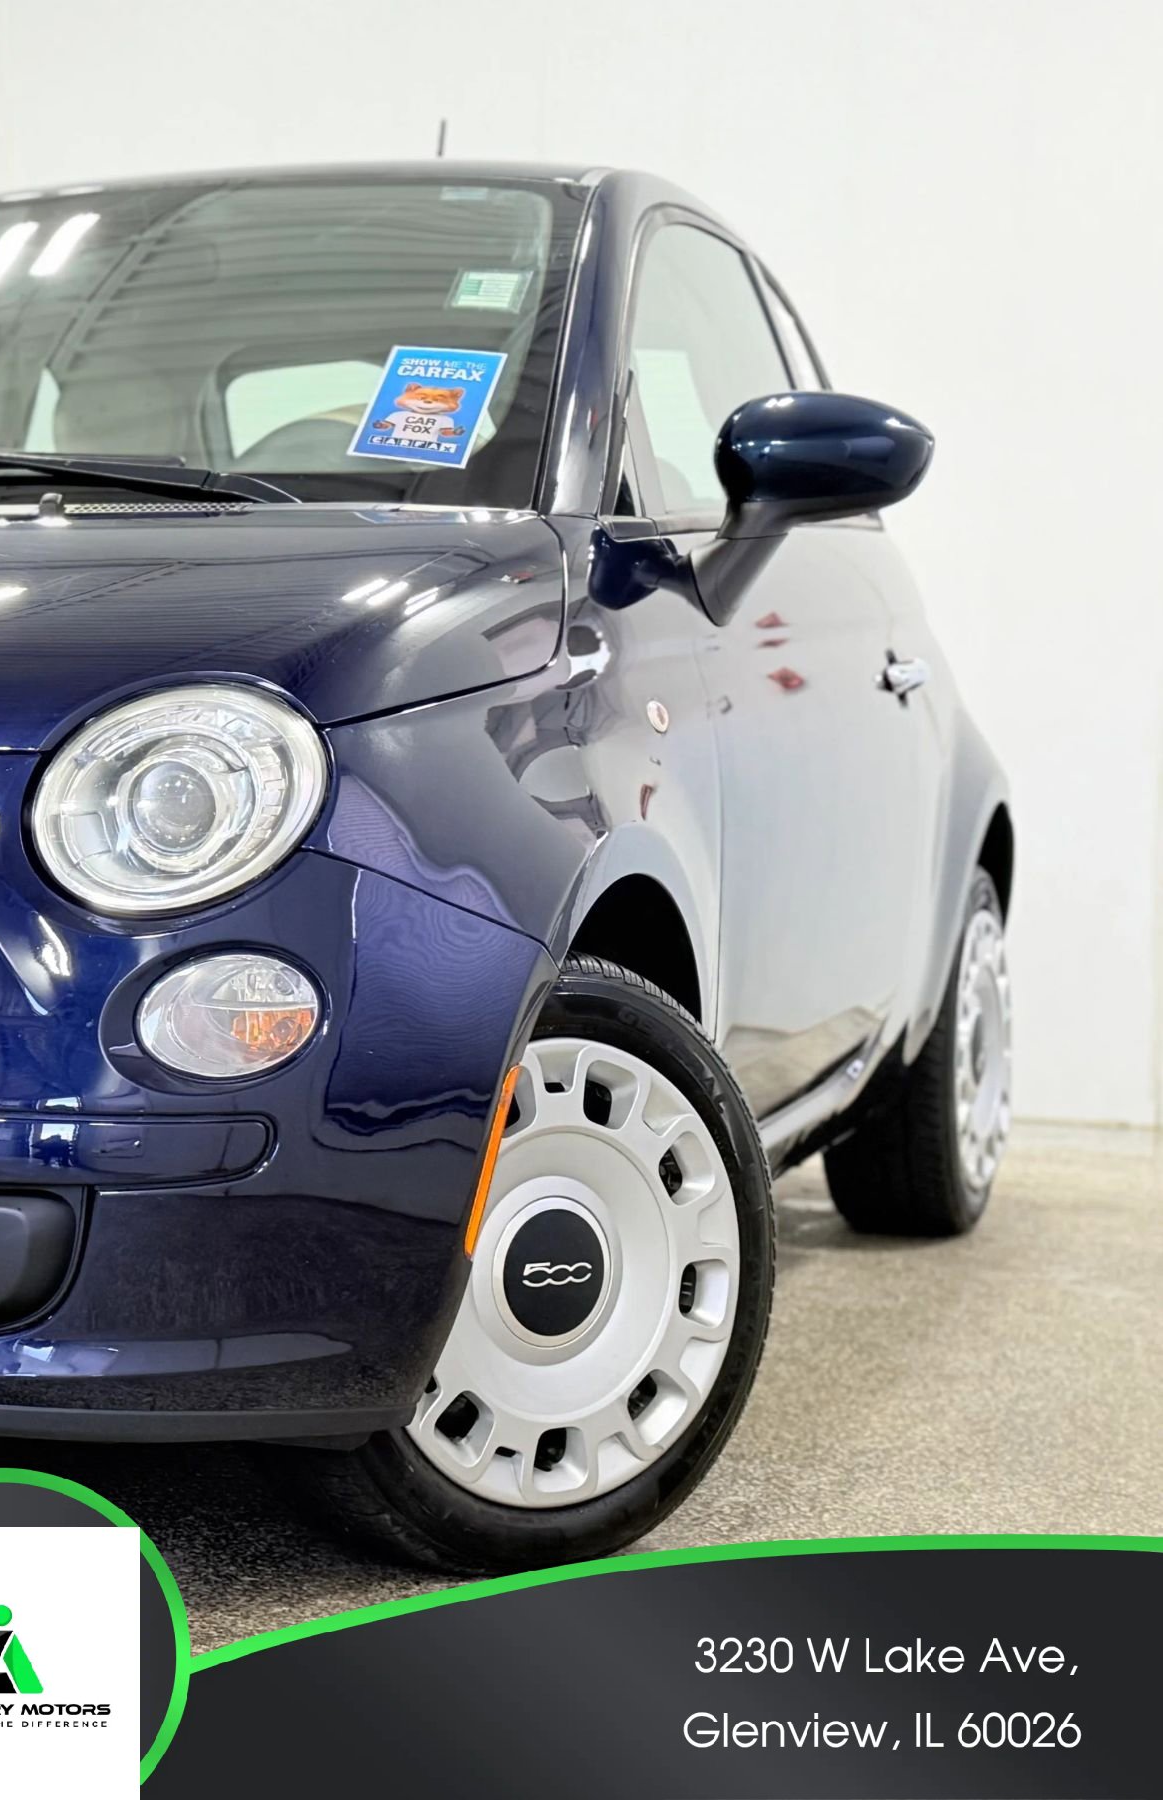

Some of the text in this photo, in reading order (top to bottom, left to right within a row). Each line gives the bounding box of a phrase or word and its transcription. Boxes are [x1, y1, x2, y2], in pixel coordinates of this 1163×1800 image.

[400, 358, 487, 370] SHOW ME THE
[397, 365, 485, 381] CARFAX
[405, 416, 437, 426] CAR
[402, 424, 432, 434] FOX
[371, 436, 455, 452] CARFAX
[522, 1262, 592, 1287] 500
